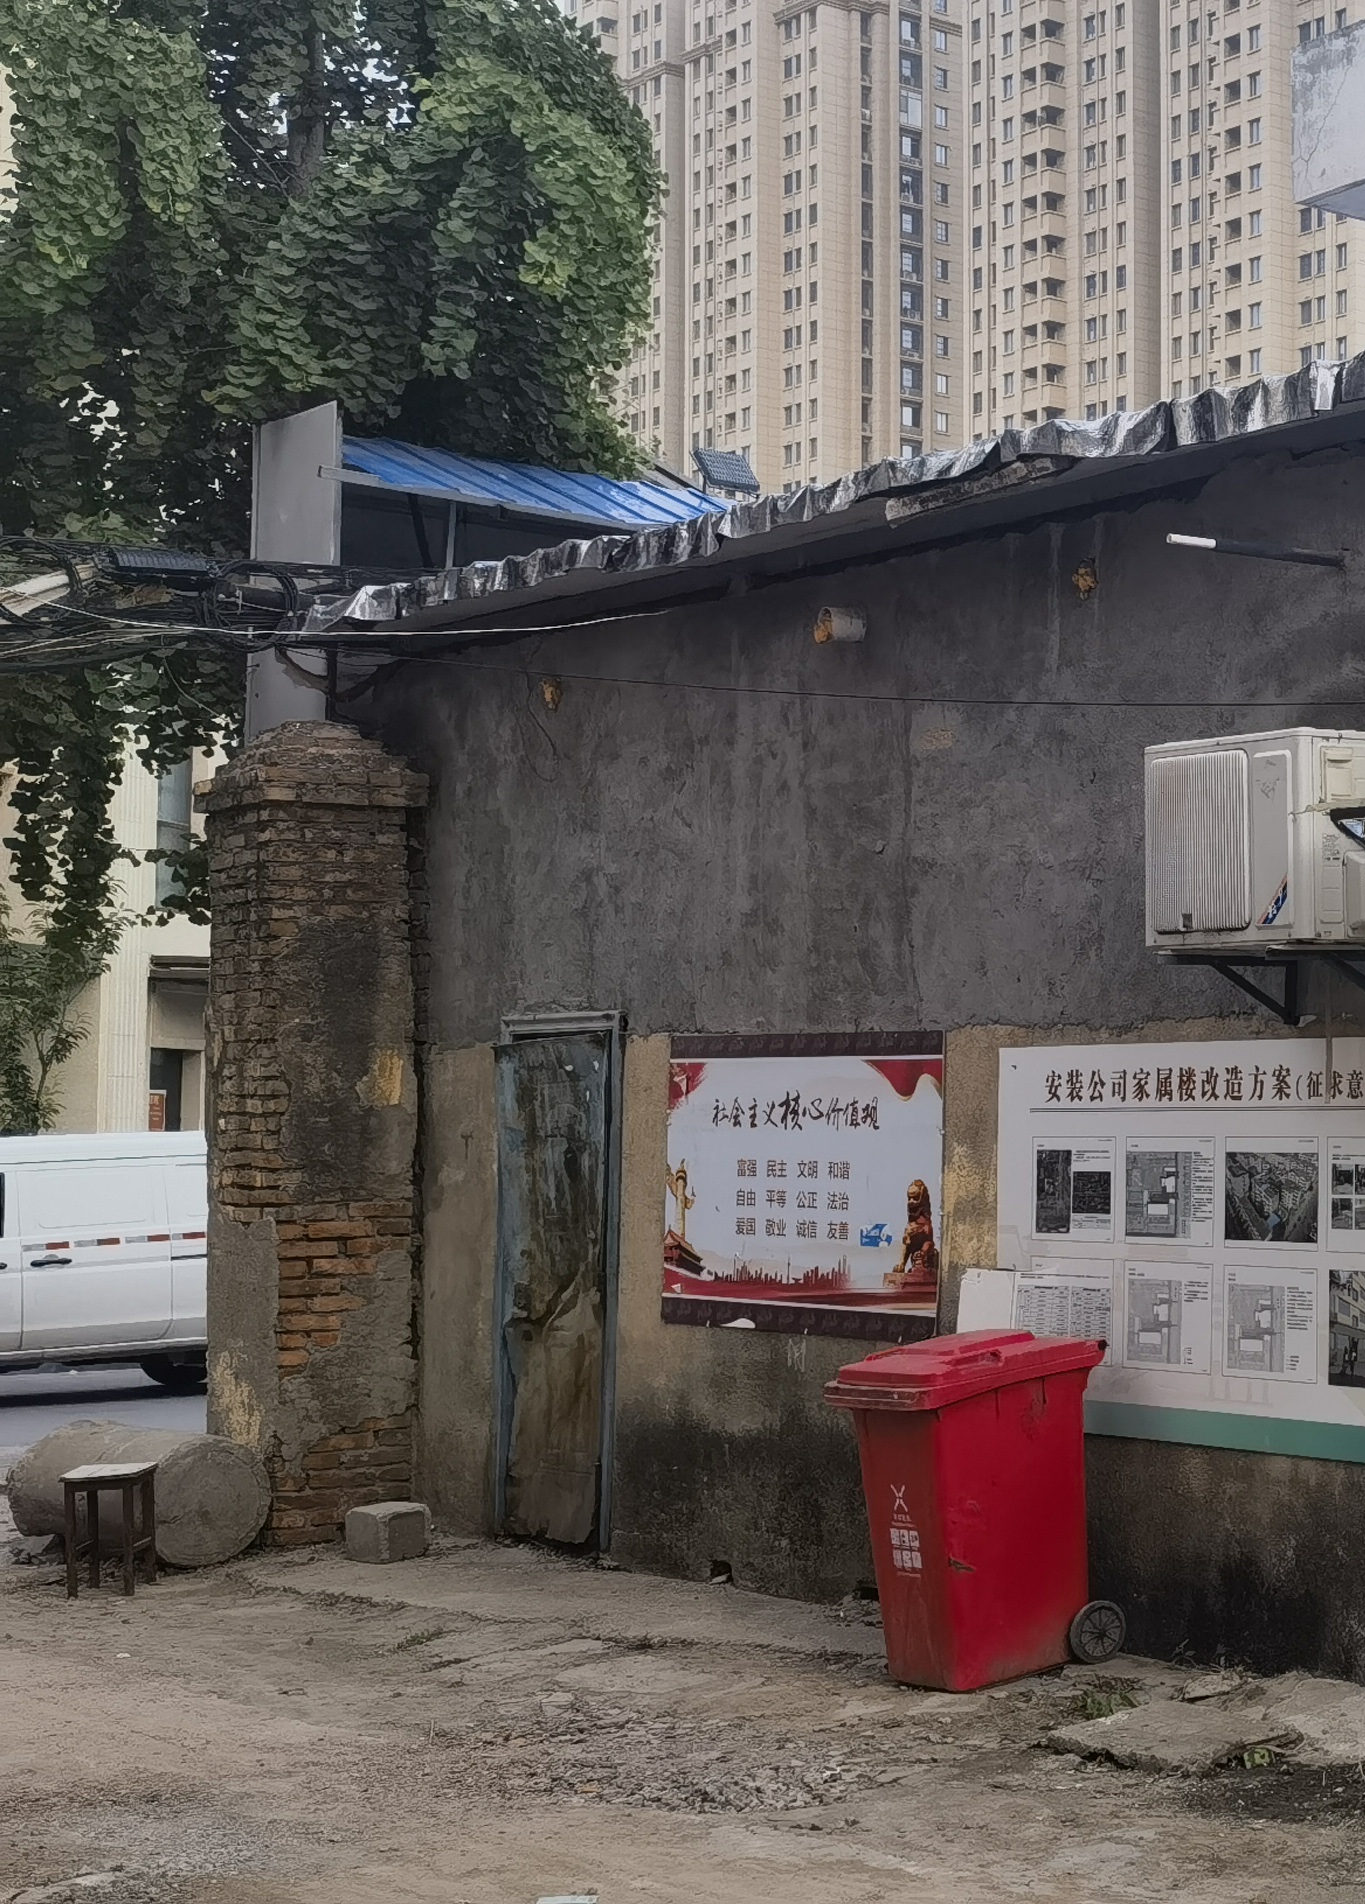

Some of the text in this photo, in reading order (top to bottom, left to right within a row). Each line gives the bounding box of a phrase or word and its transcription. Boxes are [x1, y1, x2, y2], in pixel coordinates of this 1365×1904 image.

[712, 1090, 880, 1131] 社会主义核心价值观
[737, 1158, 850, 1180] 富强 民主 文明 和谐
[736, 1188, 849, 1211] 自由 平等 公正 法治
[735, 1217, 849, 1241] 爱国 敬业 诚信 友善
